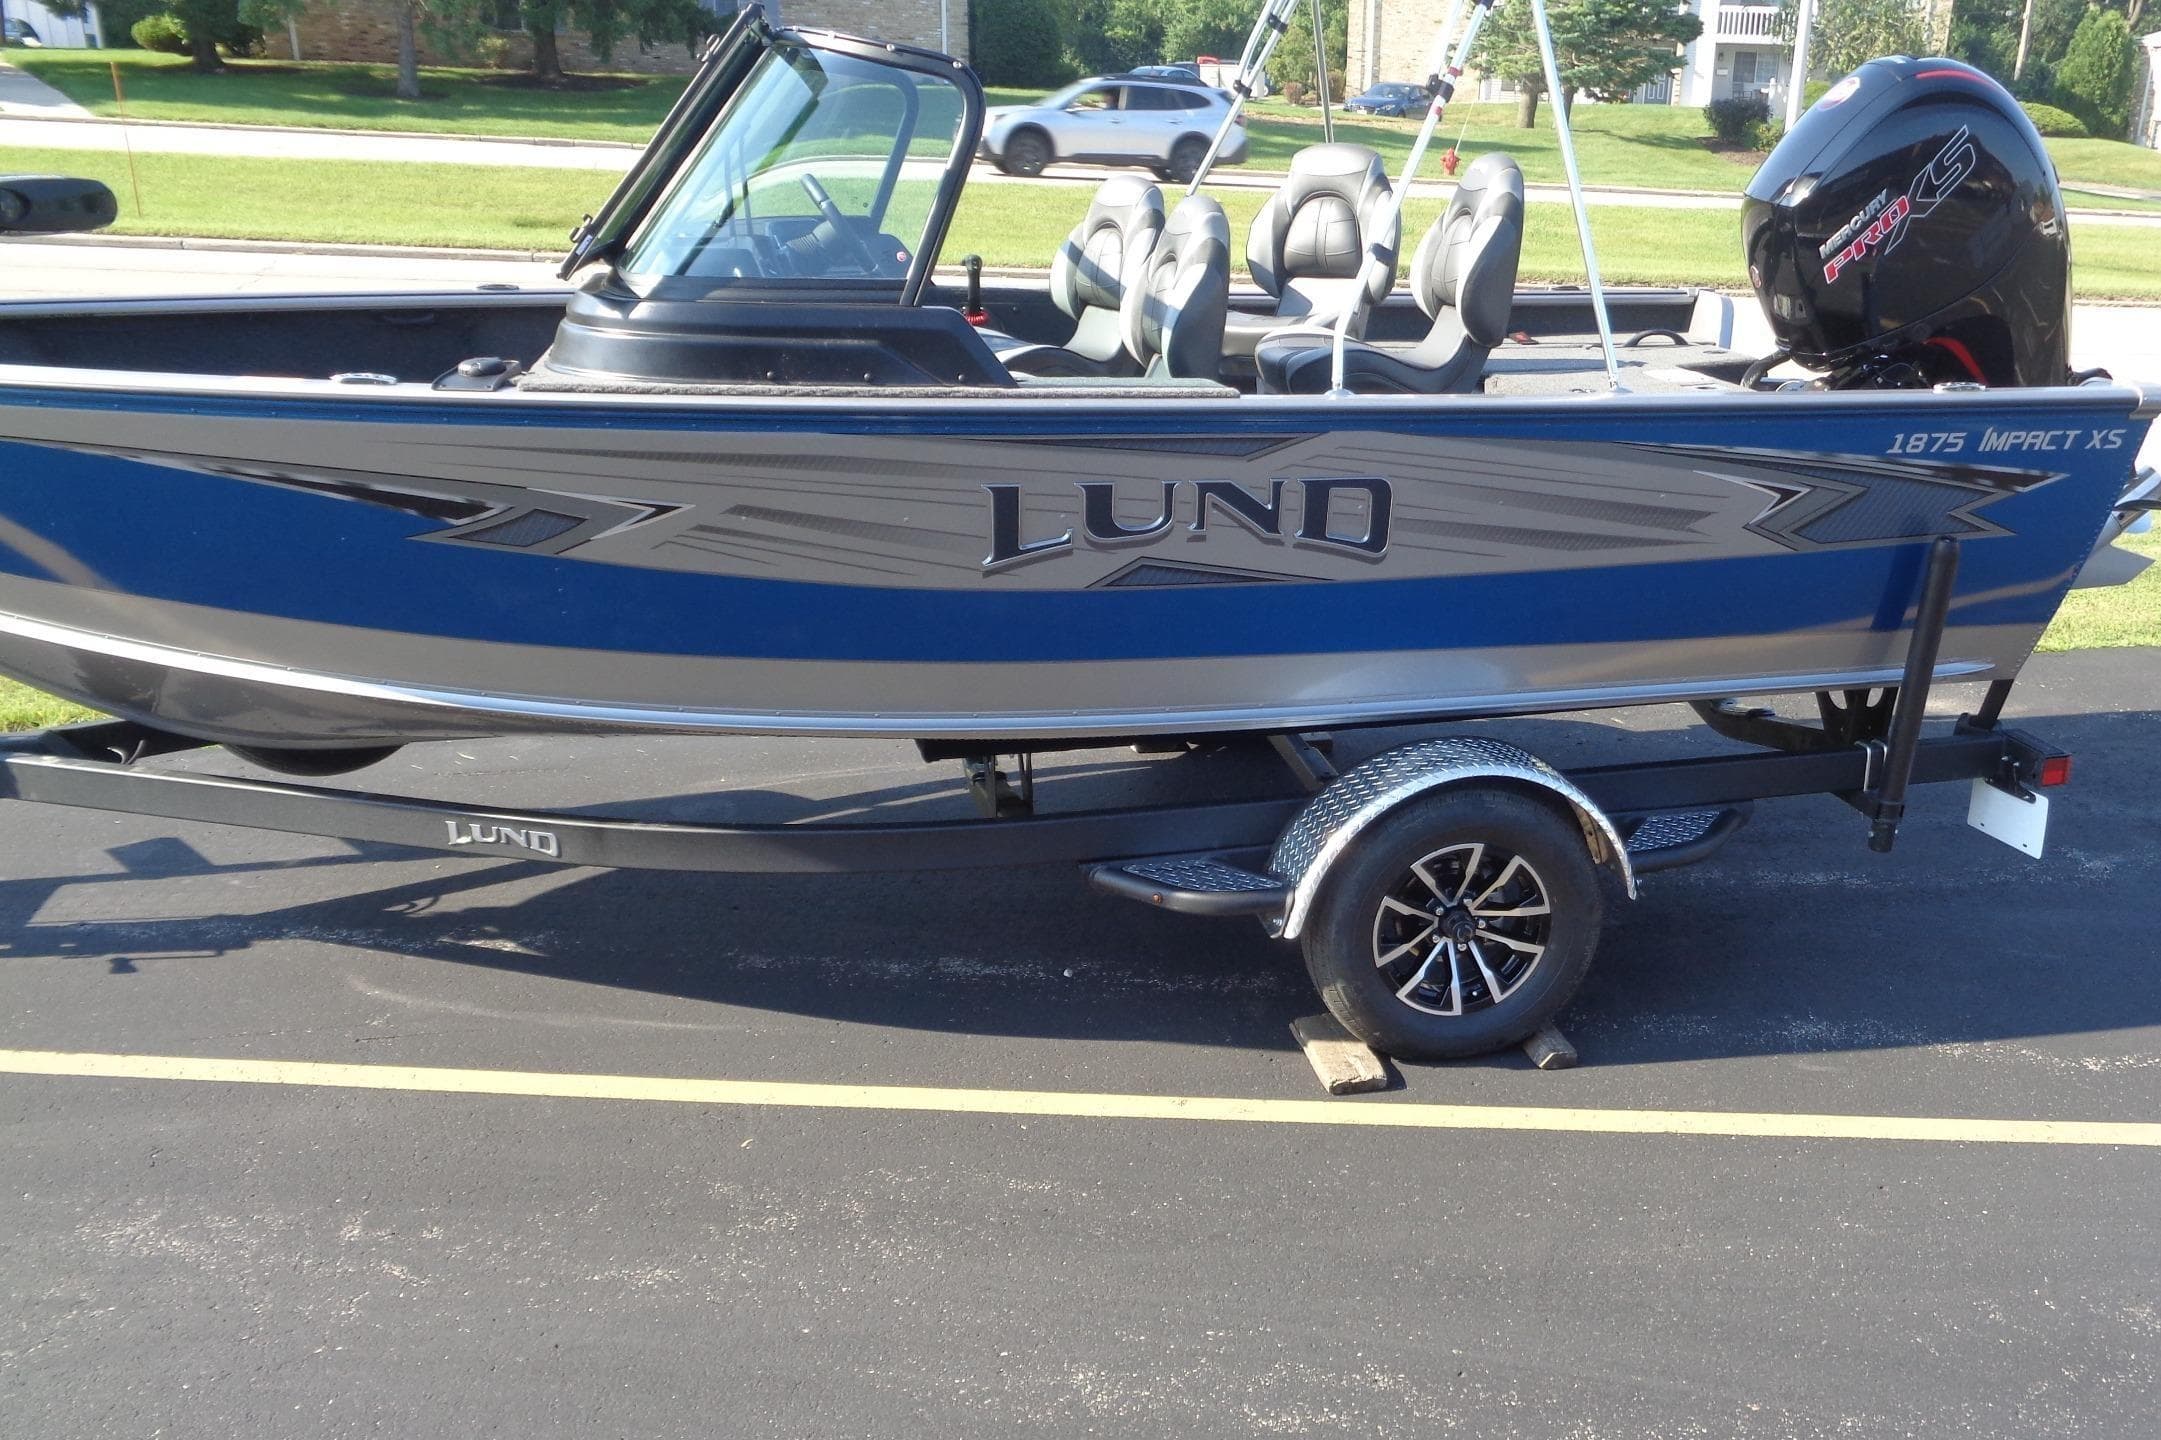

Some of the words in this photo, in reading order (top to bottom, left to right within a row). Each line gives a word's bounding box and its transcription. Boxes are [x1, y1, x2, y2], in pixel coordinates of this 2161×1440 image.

[1819, 188, 1888, 260] MERCURY
[1886, 431, 1968, 454] 1875
[1978, 426, 2082, 452] IMPACT
[2085, 428, 2127, 450] XS
[980, 477, 1394, 568] LUND
[445, 820, 559, 857] LUND
